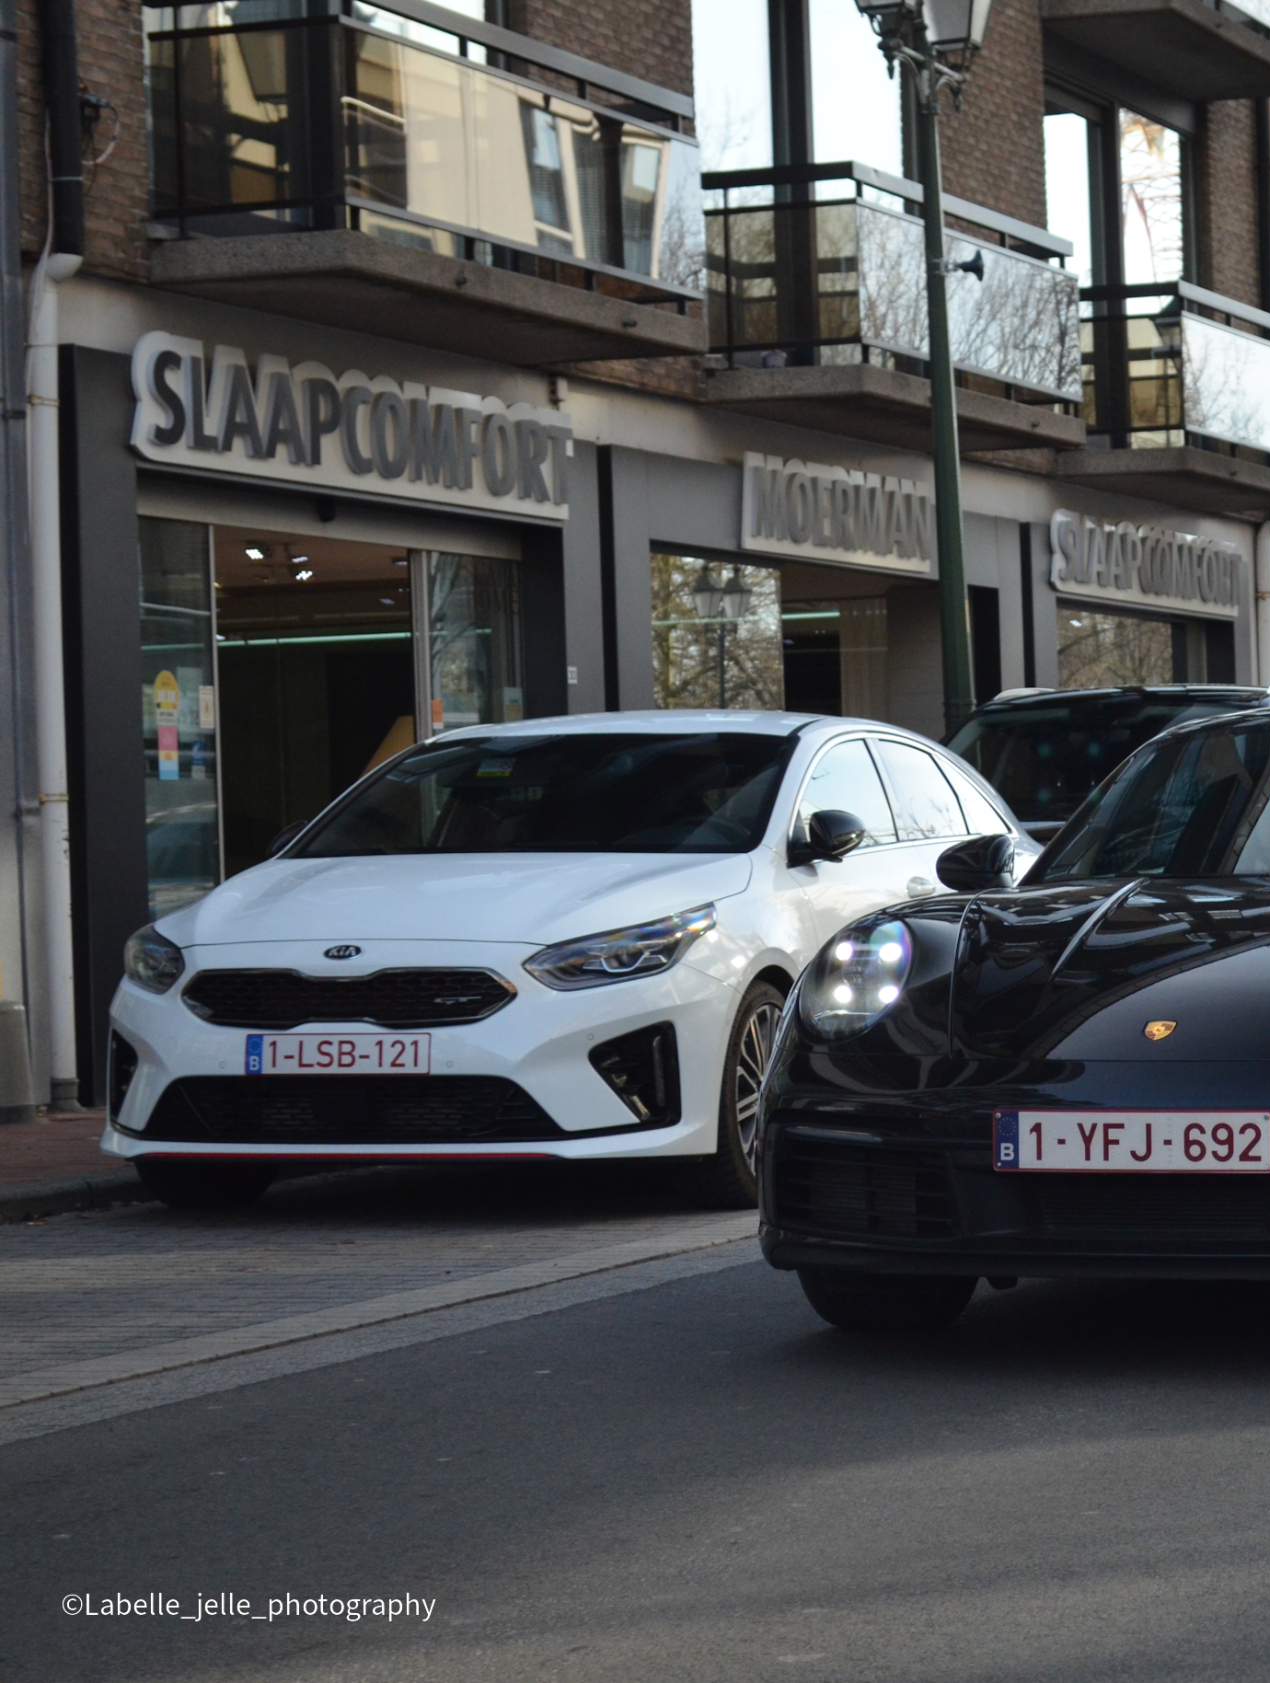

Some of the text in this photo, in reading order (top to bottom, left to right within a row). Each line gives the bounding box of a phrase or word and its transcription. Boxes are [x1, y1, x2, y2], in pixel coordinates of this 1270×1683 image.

[148, 350, 572, 506] SLAAPCOMFORT
[749, 464, 932, 561] MOERMAN
[1057, 517, 1241, 605] SLAAPCOMFORT
[328, 946, 357, 957] KIA
[250, 1055, 260, 1071] B
[269, 1039, 420, 1069] 1-LSB-121
[1000, 1142, 1015, 1161] B
[1029, 1121, 1262, 1163] 1-YFJ-692
